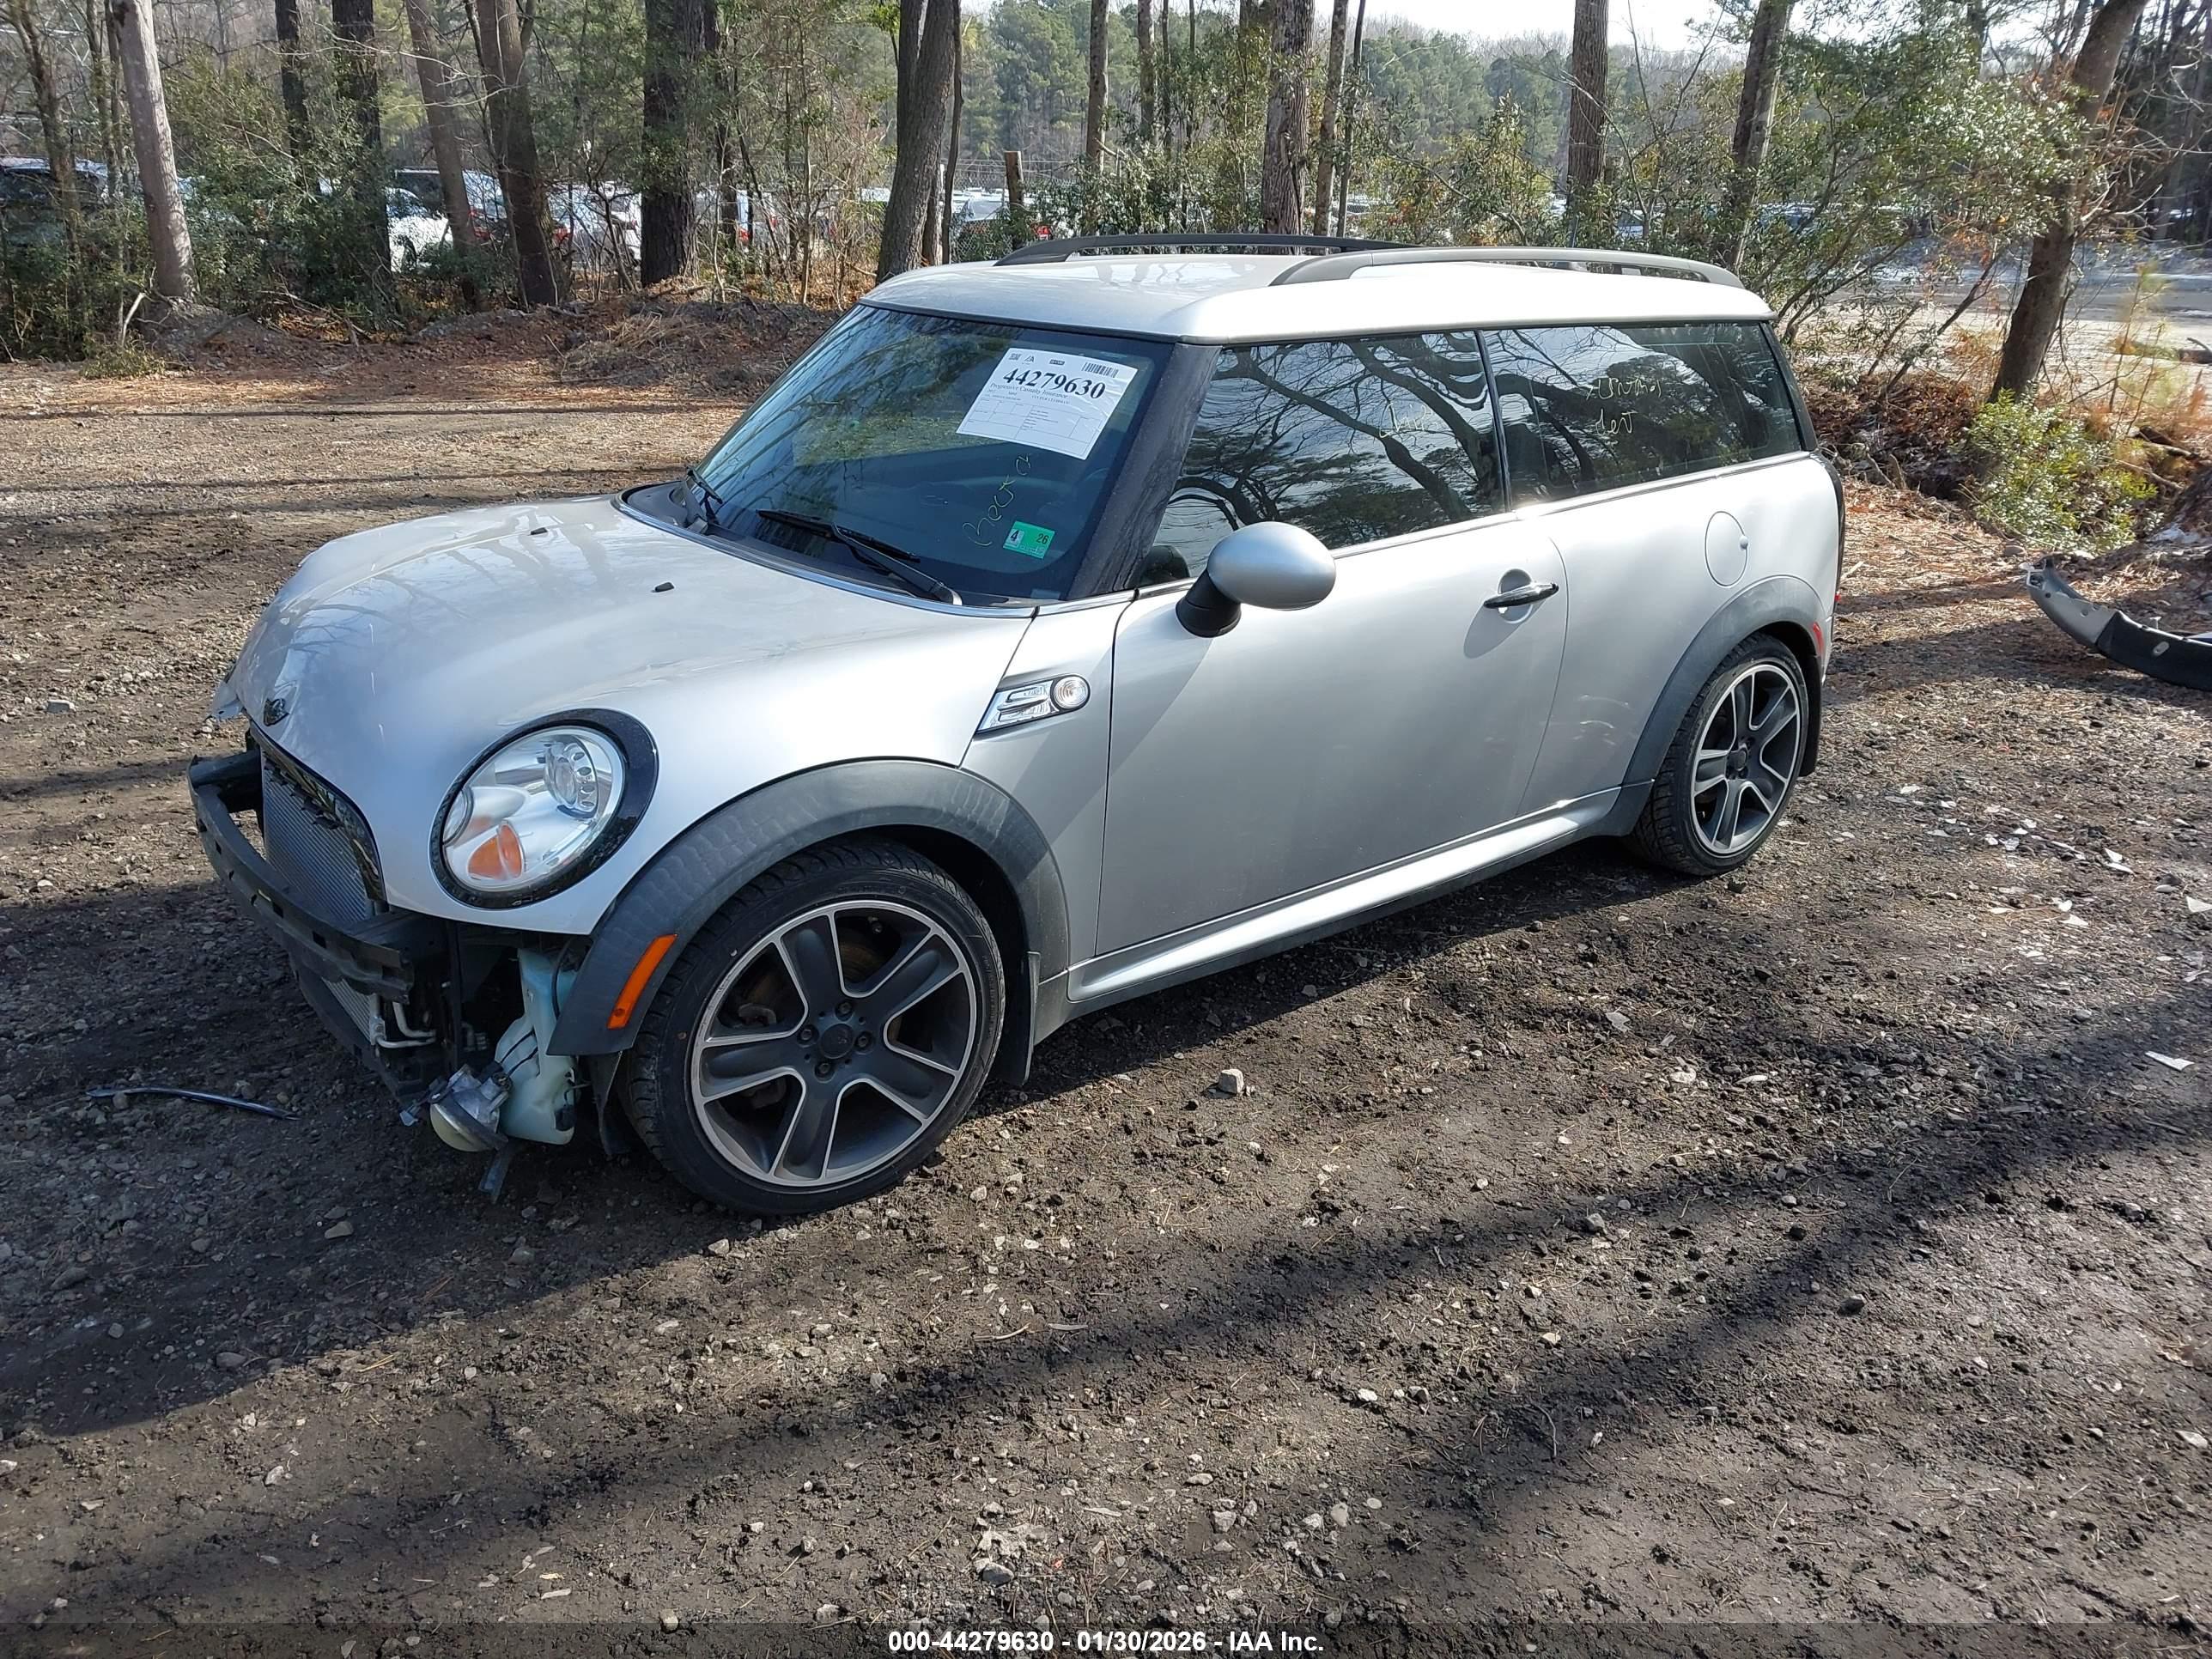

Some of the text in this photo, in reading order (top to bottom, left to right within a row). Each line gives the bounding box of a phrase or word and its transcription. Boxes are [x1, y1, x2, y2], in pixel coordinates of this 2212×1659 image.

[1003, 368, 1106, 399] 44279630
[1042, 389, 1068, 399] Insurance
[1010, 530, 1049, 544] 4 26
